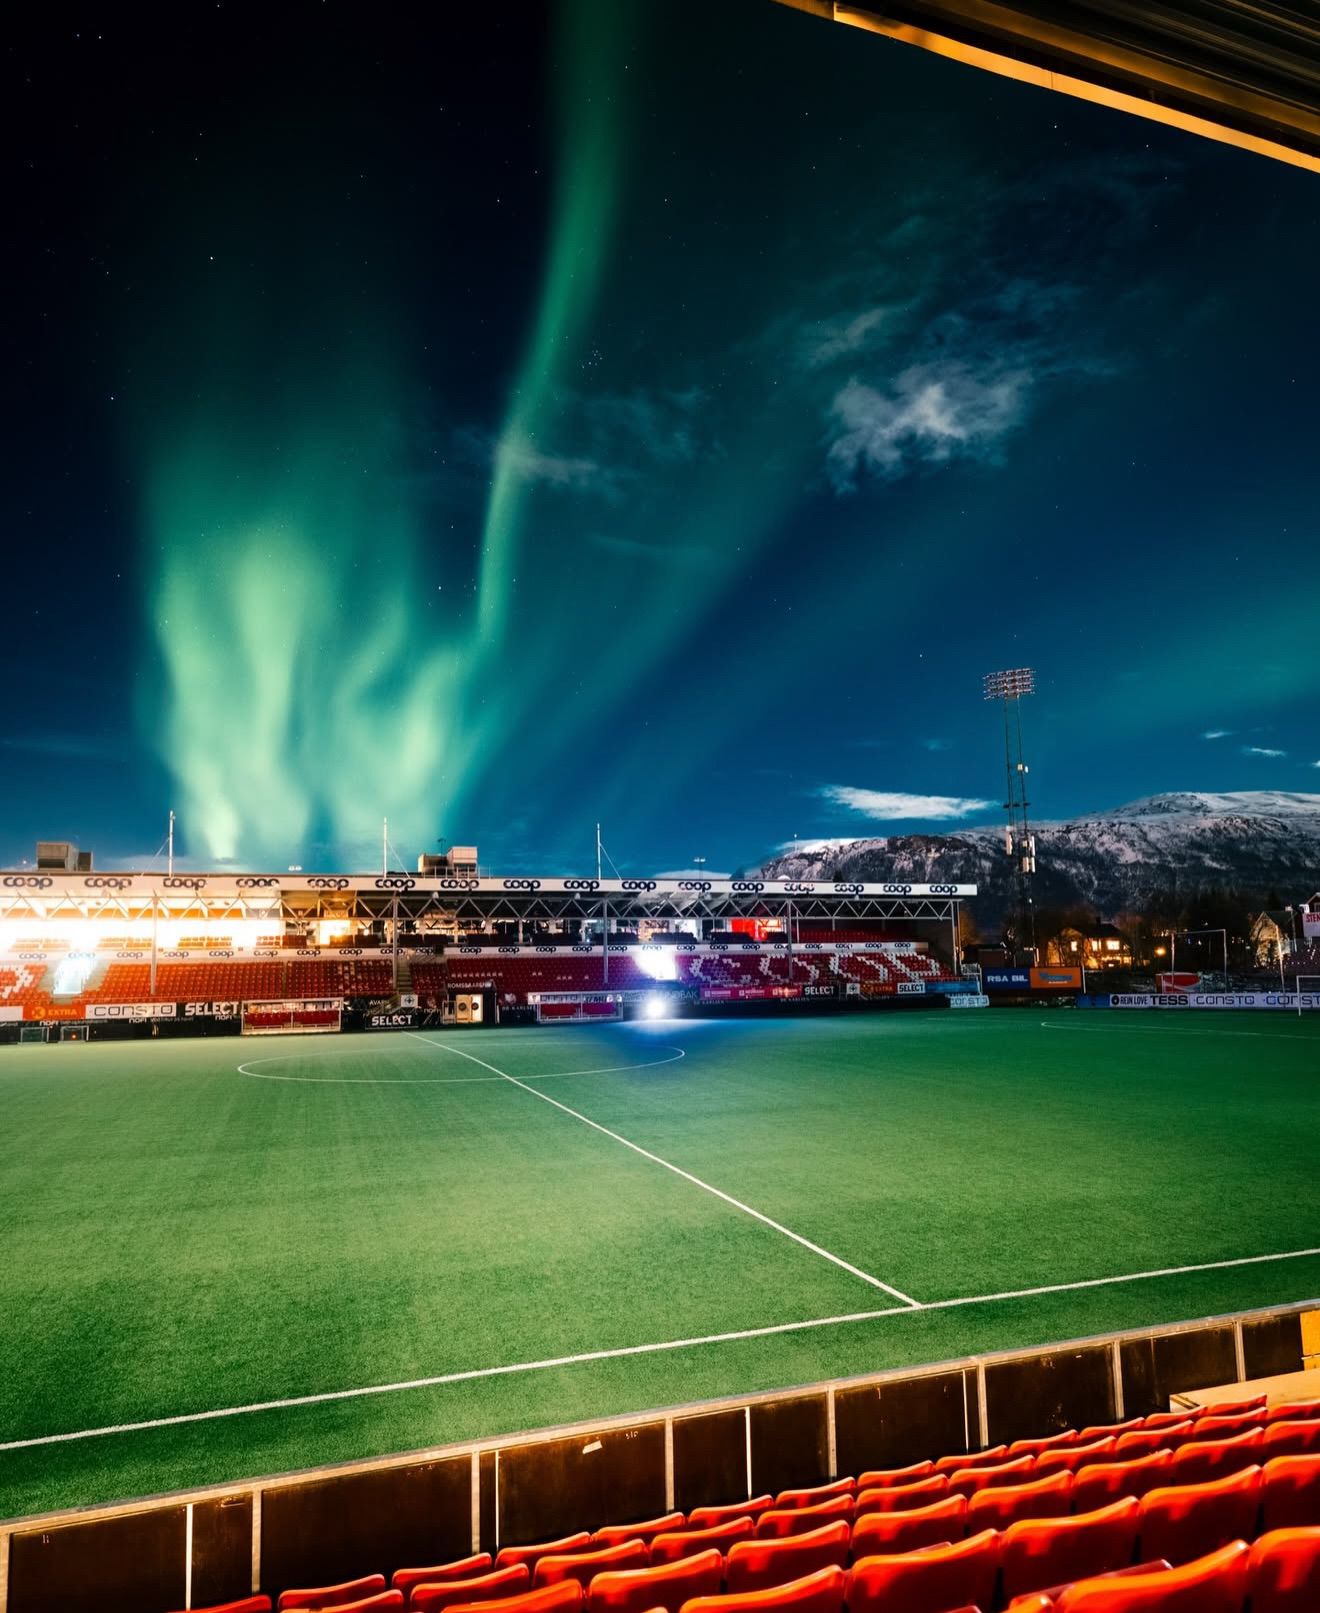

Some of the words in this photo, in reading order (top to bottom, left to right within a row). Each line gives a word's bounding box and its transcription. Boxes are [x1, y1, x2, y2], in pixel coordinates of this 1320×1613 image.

[3, 876, 53, 890] coop
[84, 878, 132, 890] coop
[163, 878, 207, 890] coop
[307, 878, 349, 890] coop
[375, 879, 416, 891] coop
[441, 879, 479, 891] coop
[503, 880, 541, 891] coop
[564, 880, 600, 892] coop
[622, 880, 657, 892] coop
[678, 882, 712, 892] coop
[732, 882, 765, 893] coop
[834, 884, 864, 895] coop
[883, 884, 912, 896] coop
[930, 884, 958, 896] coop
[460, 947, 482, 955] coop
[804, 986, 834, 995] SELECT
[1150, 995, 1188, 1005] TESS
[184, 1002, 238, 1016] SELECT
[372, 1014, 412, 1026] SELECT
